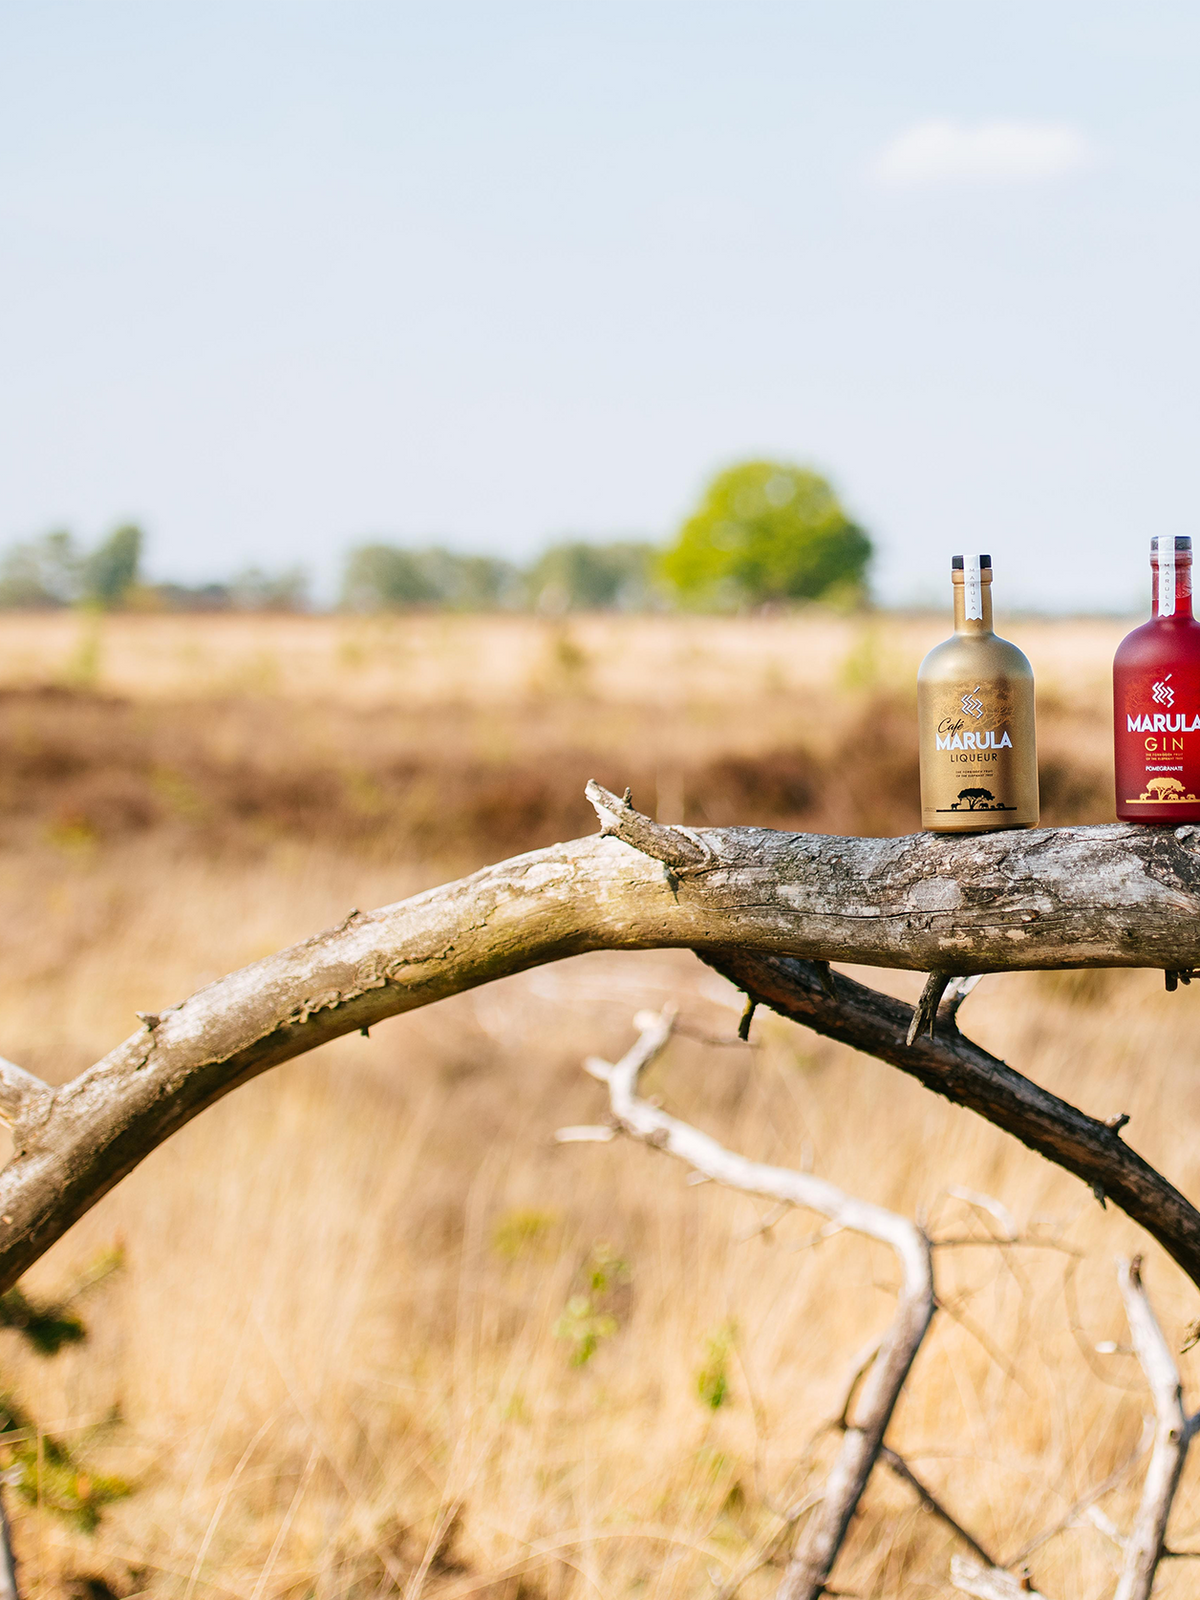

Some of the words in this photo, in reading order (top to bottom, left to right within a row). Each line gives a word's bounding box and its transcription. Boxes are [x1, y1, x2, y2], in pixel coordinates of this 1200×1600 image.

[969, 568, 977, 610] MARULA
[937, 717, 965, 738] Café
[935, 731, 1013, 751] MARULA
[1144, 737, 1184, 752] GIN
[950, 752, 998, 763] LIQUEUR
